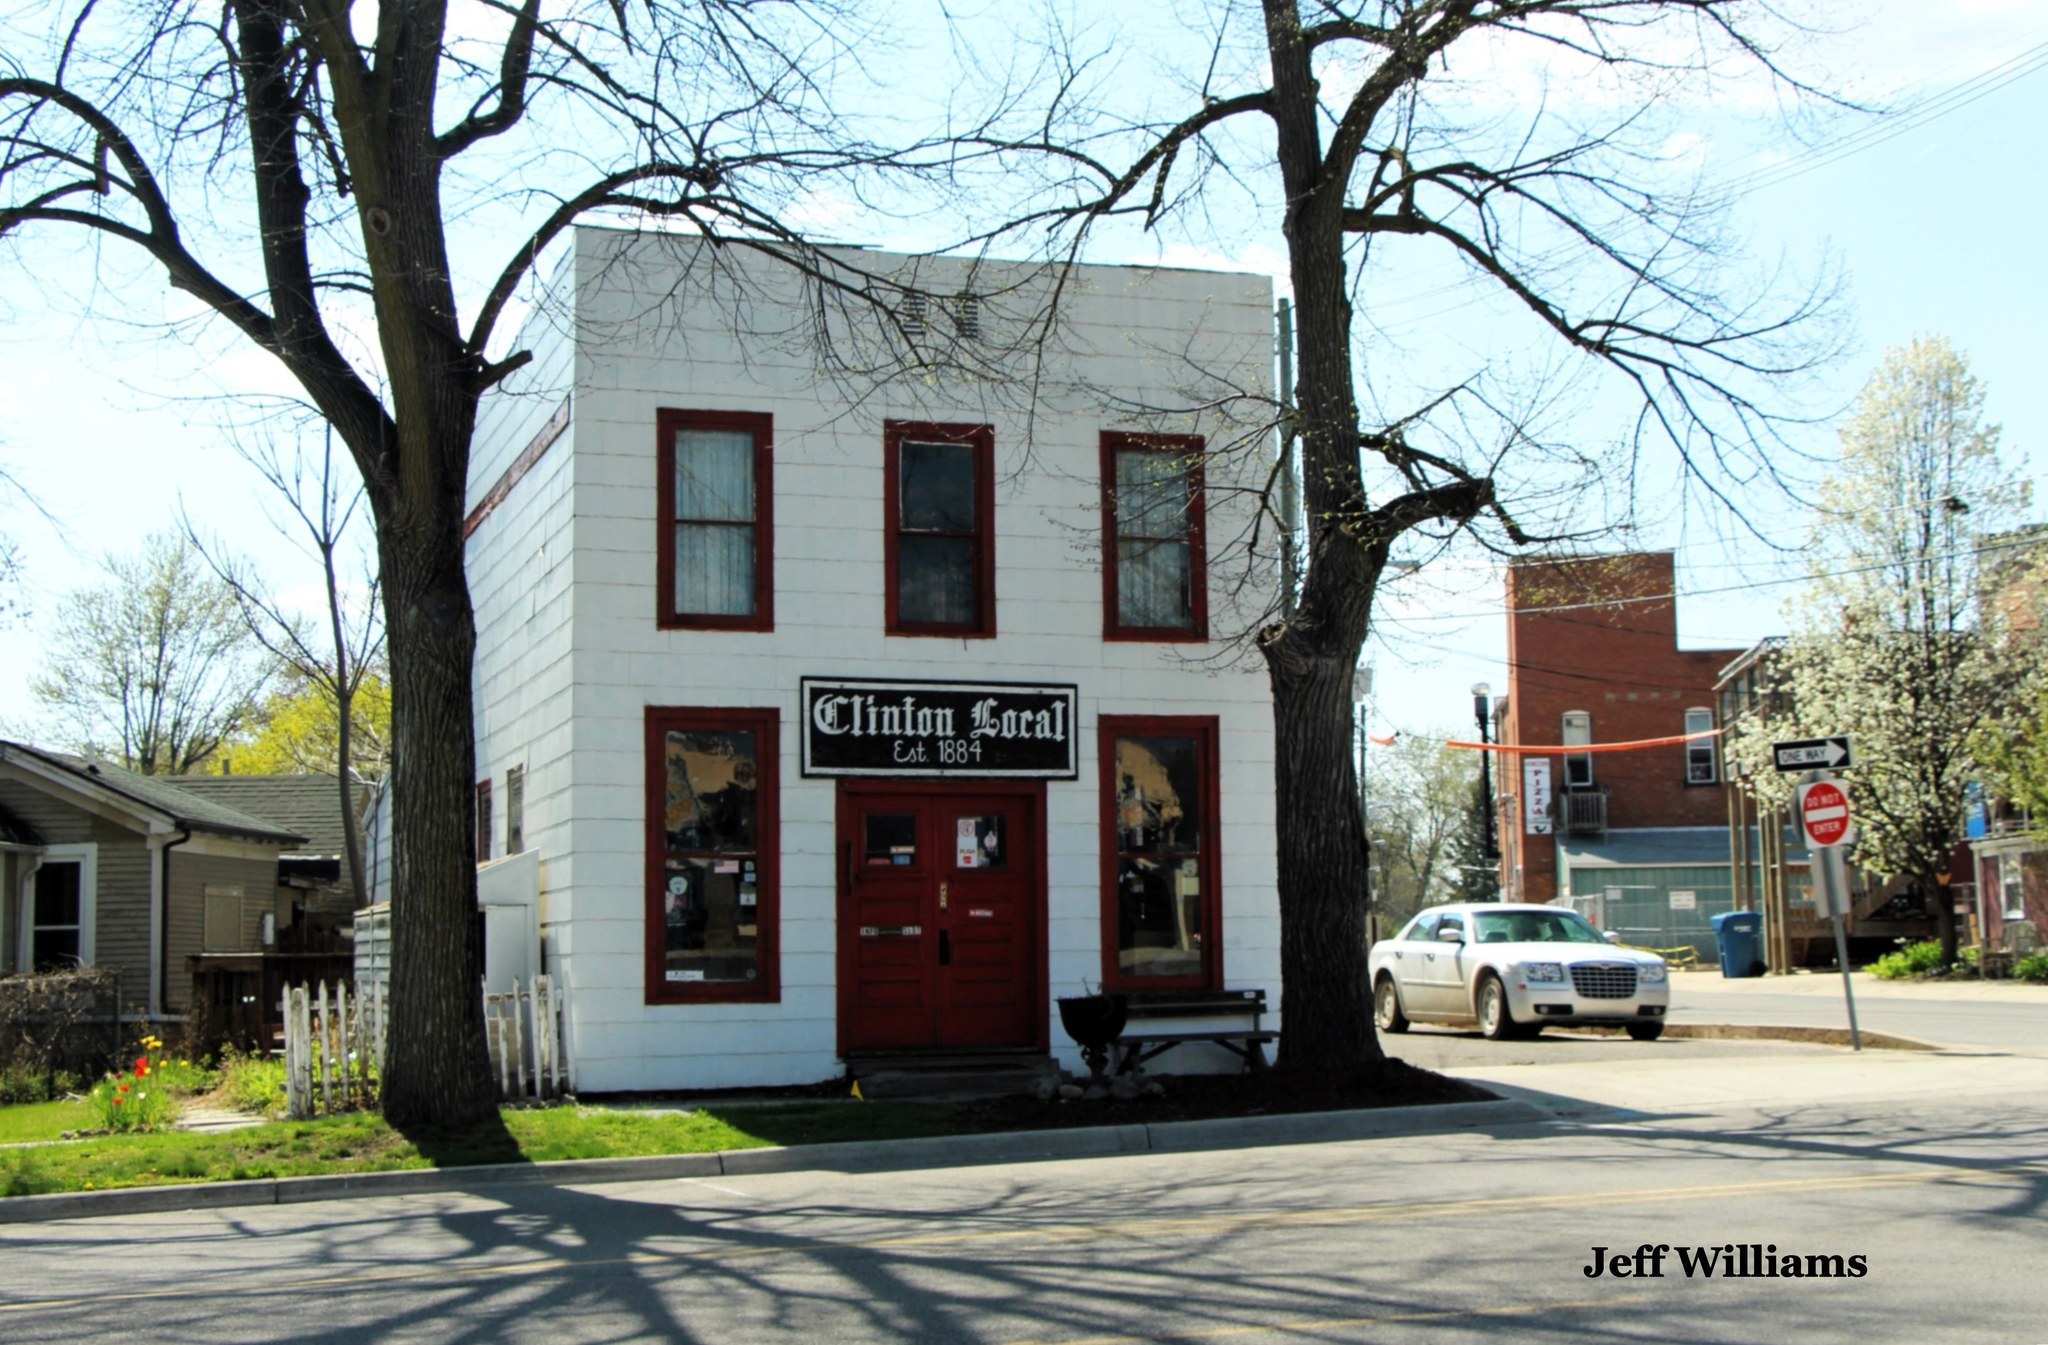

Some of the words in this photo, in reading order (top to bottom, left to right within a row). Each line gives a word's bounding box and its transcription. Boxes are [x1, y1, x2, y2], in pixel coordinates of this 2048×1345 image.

[812, 693, 955, 737] Clinton
[970, 697, 1066, 742] Local
[893, 739, 930, 763] Est.
[937, 739, 982, 763] 1884
[1782, 750, 1802, 763] ONE
[1806, 748, 1826, 760] WAY
[1532, 769, 1543, 815] PIZZA
[1806, 797, 1819, 808] DO
[1821, 792, 1840, 805] NOT
[1813, 821, 1841, 835] ENTER
